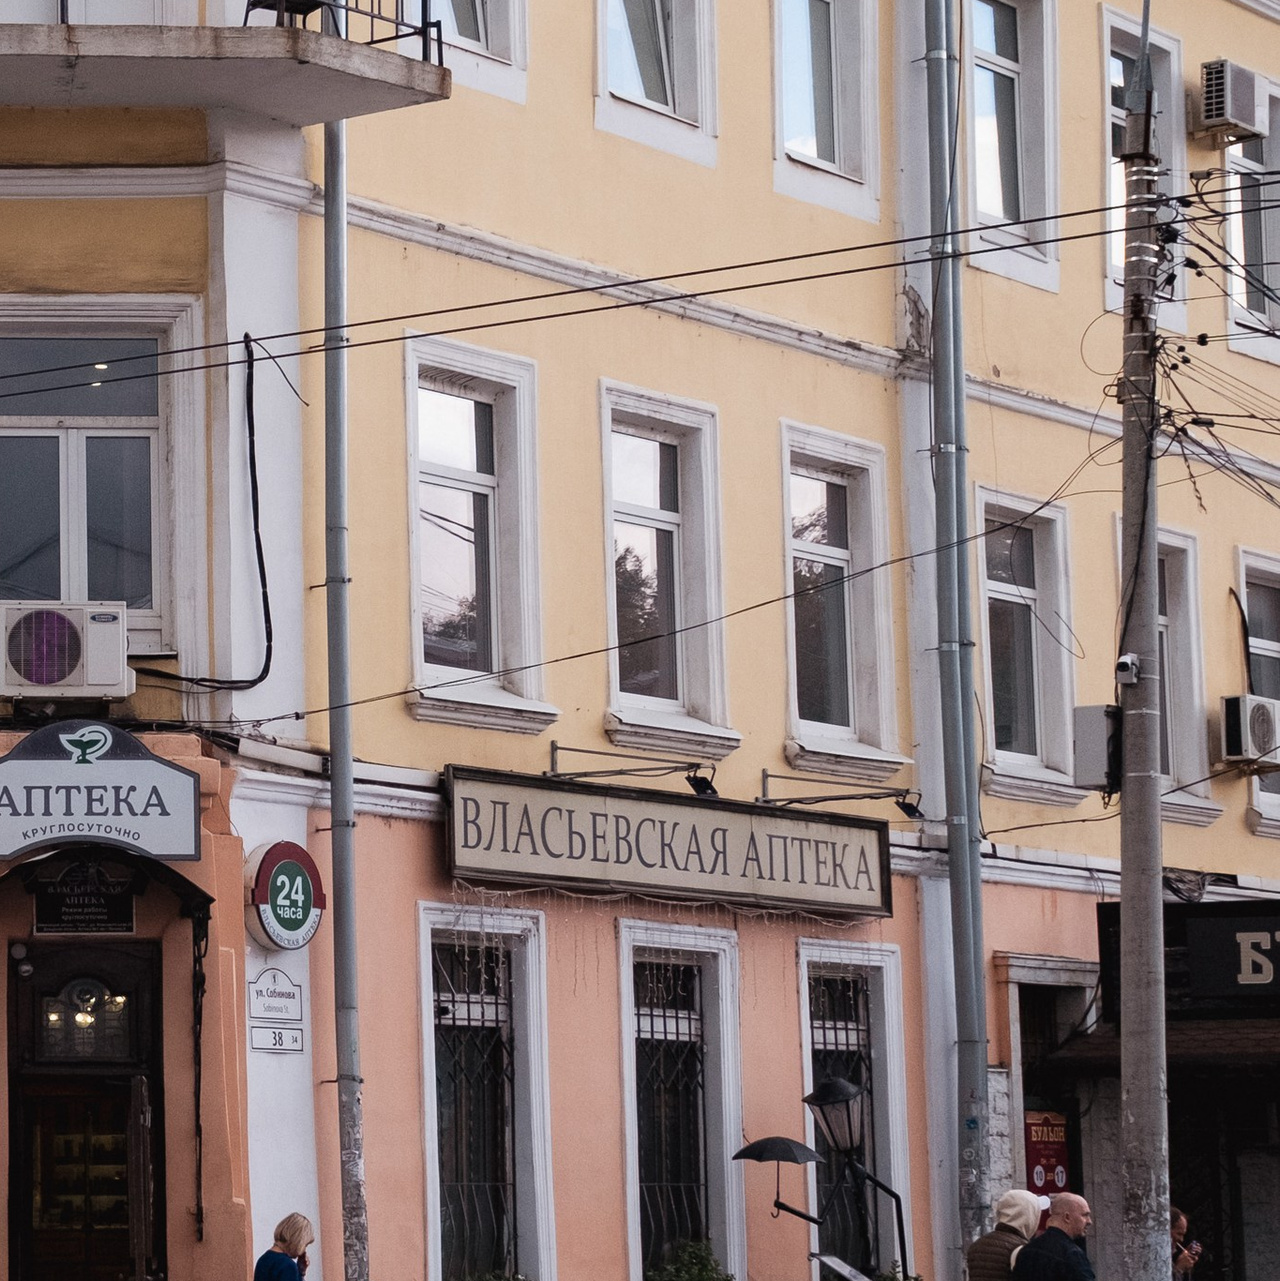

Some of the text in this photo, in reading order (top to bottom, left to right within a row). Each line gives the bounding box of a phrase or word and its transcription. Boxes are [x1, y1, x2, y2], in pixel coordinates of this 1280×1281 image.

[22, 822, 141, 841] КРУГЛОСУТОЧНО
[460, 796, 876, 892] ВЛАСЬЕВСКАЯ АПТЕКА
[276, 874, 305, 907] 24
[65, 896, 105, 904] АПТЕКА
[277, 906, 303, 919] часа
[1235, 930, 1280, 984] Б
[255, 987, 296, 999] ул. Собинова
[272, 1031, 284, 1047] 38
[1030, 1126, 1065, 1142] БУЛЬОН
[1035, 1170, 1043, 1181] 10
[1056, 1170, 1064, 1183] 17
